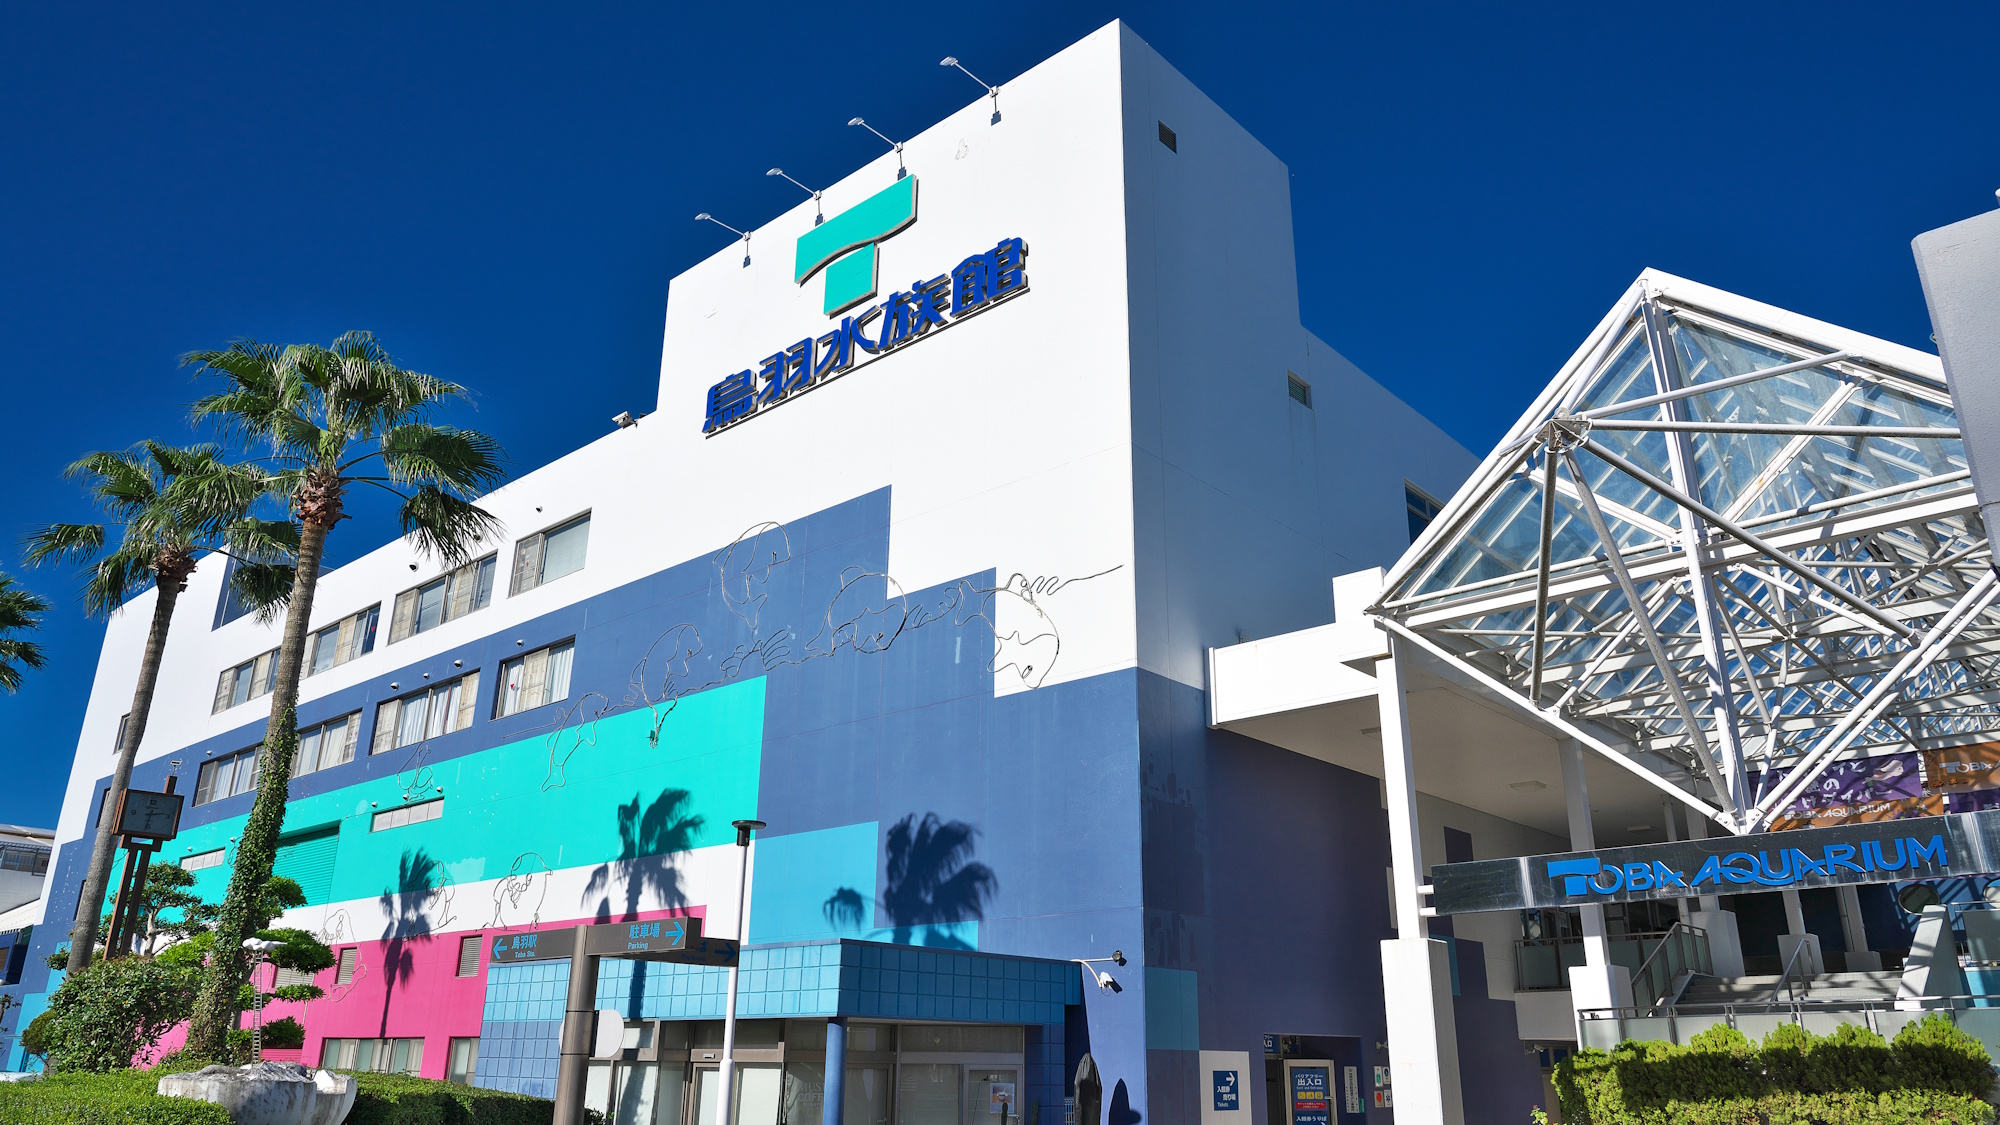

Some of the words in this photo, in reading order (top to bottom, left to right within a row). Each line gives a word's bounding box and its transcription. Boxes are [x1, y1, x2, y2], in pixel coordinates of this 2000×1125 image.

[702, 237, 1029, 434] 鳥羽水族館
[1939, 761, 1993, 774] TOBA
[1782, 810, 1821, 821] TOBA
[1823, 803, 1891, 818] AQUARIUM
[1547, 857, 1689, 897] TOBA
[1690, 835, 1949, 887] AQUARIUM
[629, 922, 660, 939] 駐車場
[511, 934, 538, 949] 鳥羽駅
[628, 942, 648, 950] Parking
